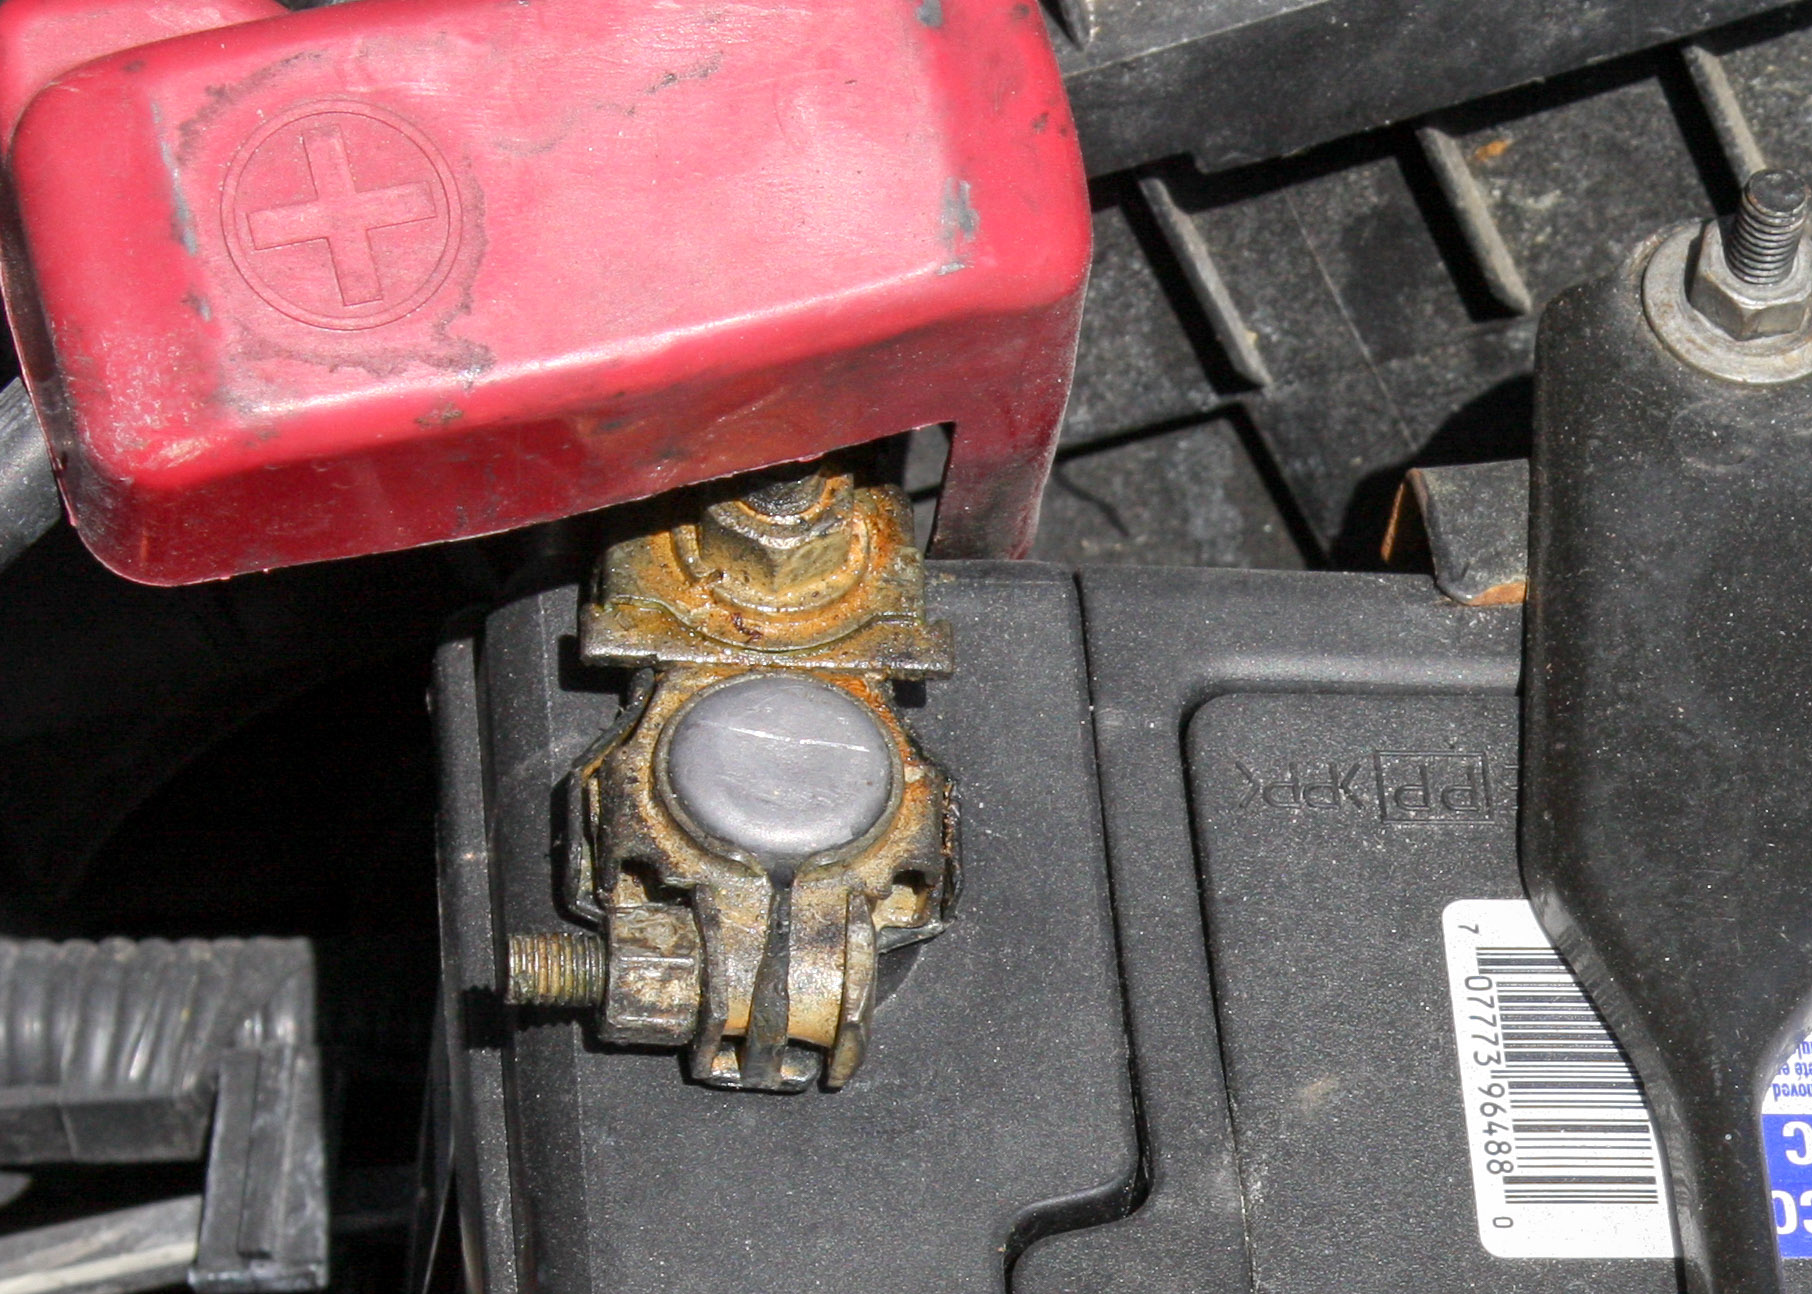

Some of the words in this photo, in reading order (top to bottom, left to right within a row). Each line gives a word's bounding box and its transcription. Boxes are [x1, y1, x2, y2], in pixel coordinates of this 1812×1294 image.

[1464, 976, 1501, 1066] 07773
[1477, 1083, 1515, 1175] 96488
[1492, 1216, 1514, 1229] 0
